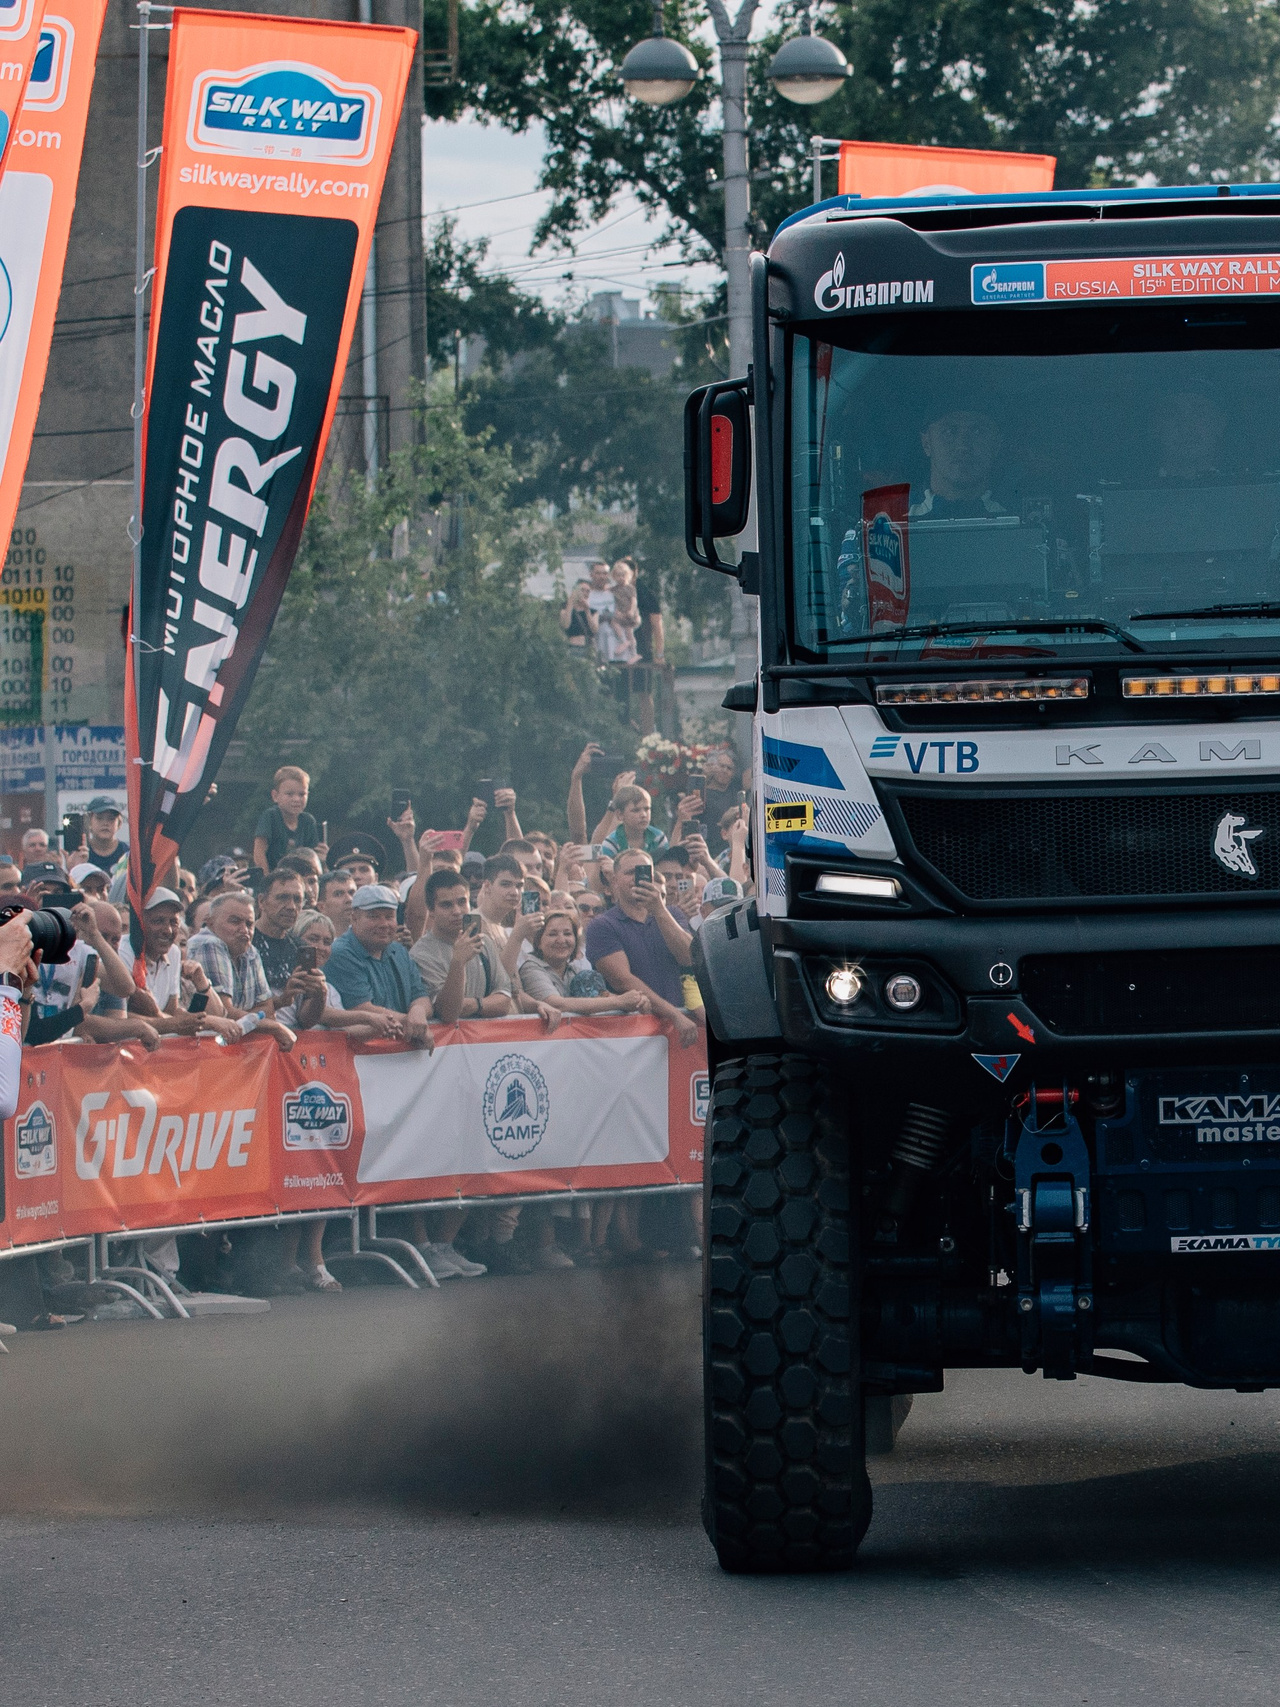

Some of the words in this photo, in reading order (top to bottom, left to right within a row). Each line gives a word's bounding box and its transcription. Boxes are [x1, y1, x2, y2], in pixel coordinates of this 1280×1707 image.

[208, 91, 288, 118] SILK
[291, 98, 362, 124] WAY
[242, 117, 323, 133] RALLY
[179, 163, 369, 198] silkwayrally.com
[1133, 264, 1175, 278] SILK
[1179, 262, 1222, 276] WAY
[846, 280, 934, 309] ГАЗПРОМ
[997, 282, 1035, 293] GAZPROM
[1054, 281, 1120, 296] RUSSIA
[1139, 279, 1166, 293] 15th
[1170, 277, 1245, 292] EDITION
[191, 240, 232, 398] МАСЛО
[904, 741, 980, 774] VTB
[304, 1095, 326, 1104] 2025
[288, 1105, 312, 1120] SILK
[315, 1105, 344, 1120] WAY
[20, 1129, 39, 1146] SILK
[492, 1124, 541, 1141] CAMF
[283, 1172, 344, 1190] #silkwayrally2025
